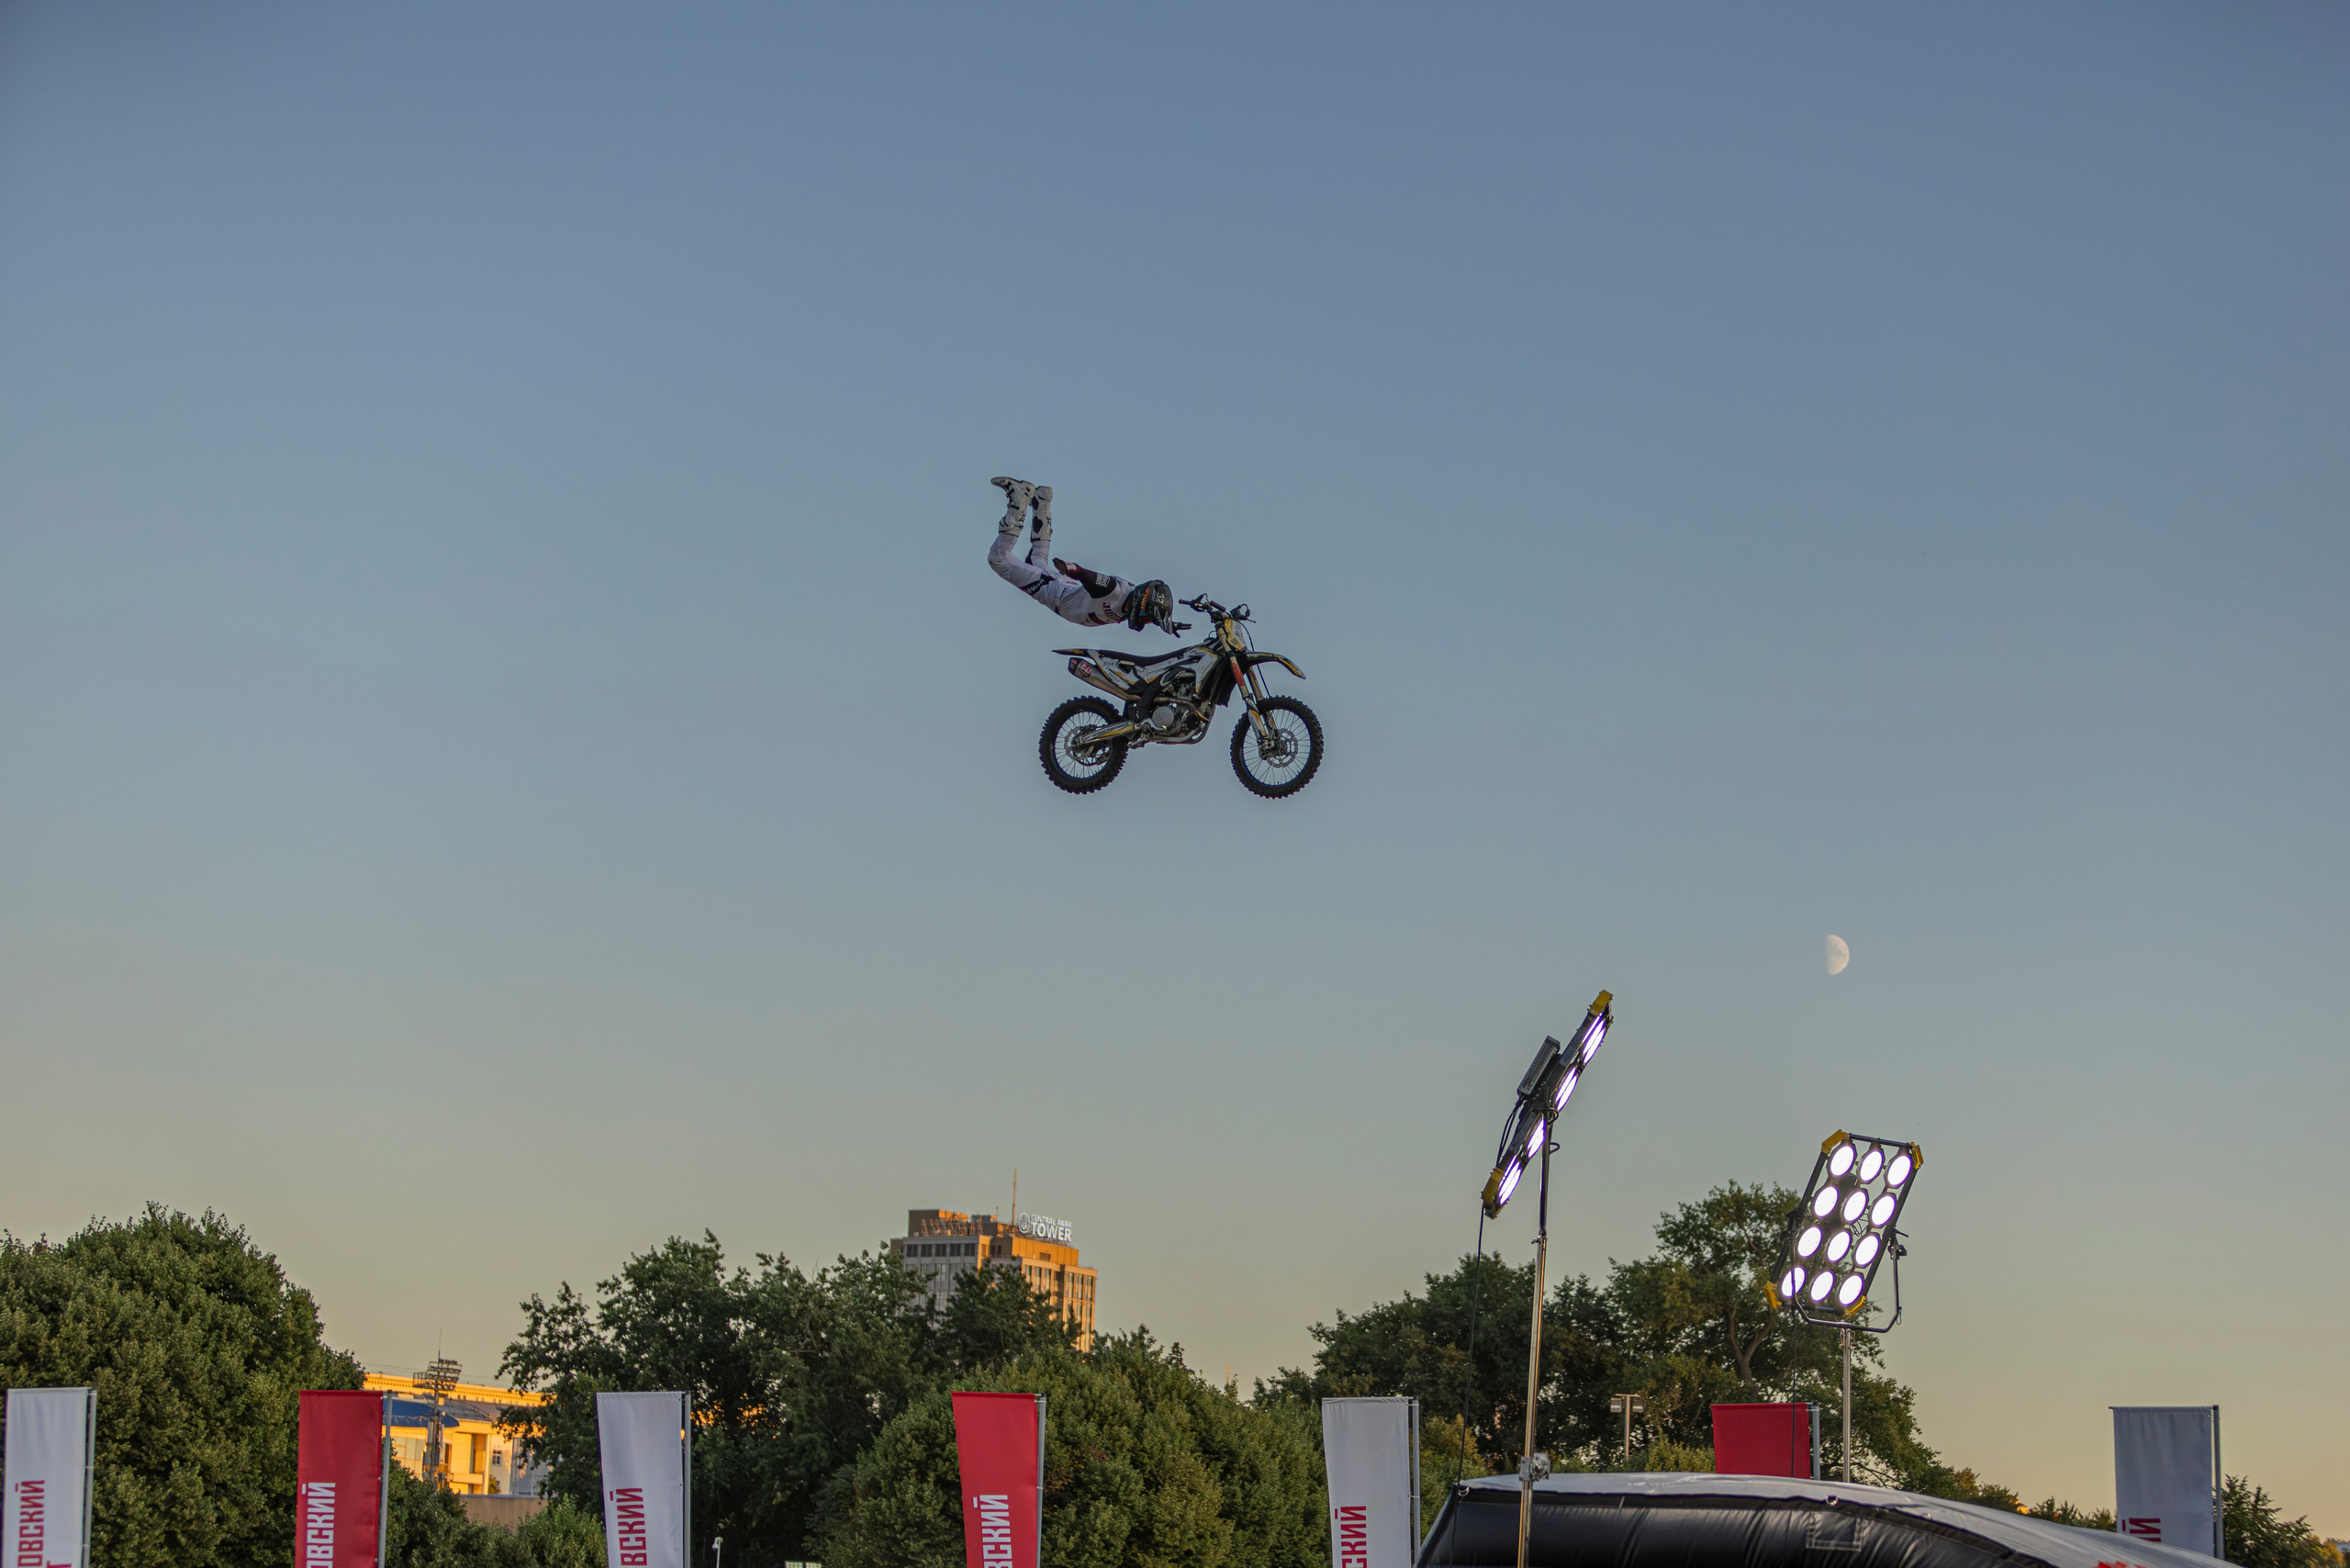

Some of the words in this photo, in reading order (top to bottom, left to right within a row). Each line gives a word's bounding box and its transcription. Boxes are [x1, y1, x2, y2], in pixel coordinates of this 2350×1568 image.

[1030, 1214, 1056, 1226] CENTRAL
[1057, 1219, 1072, 1228] PARK
[1030, 1222, 1071, 1242] TOWER
[609, 1487, 647, 1566] ВСКИЙ
